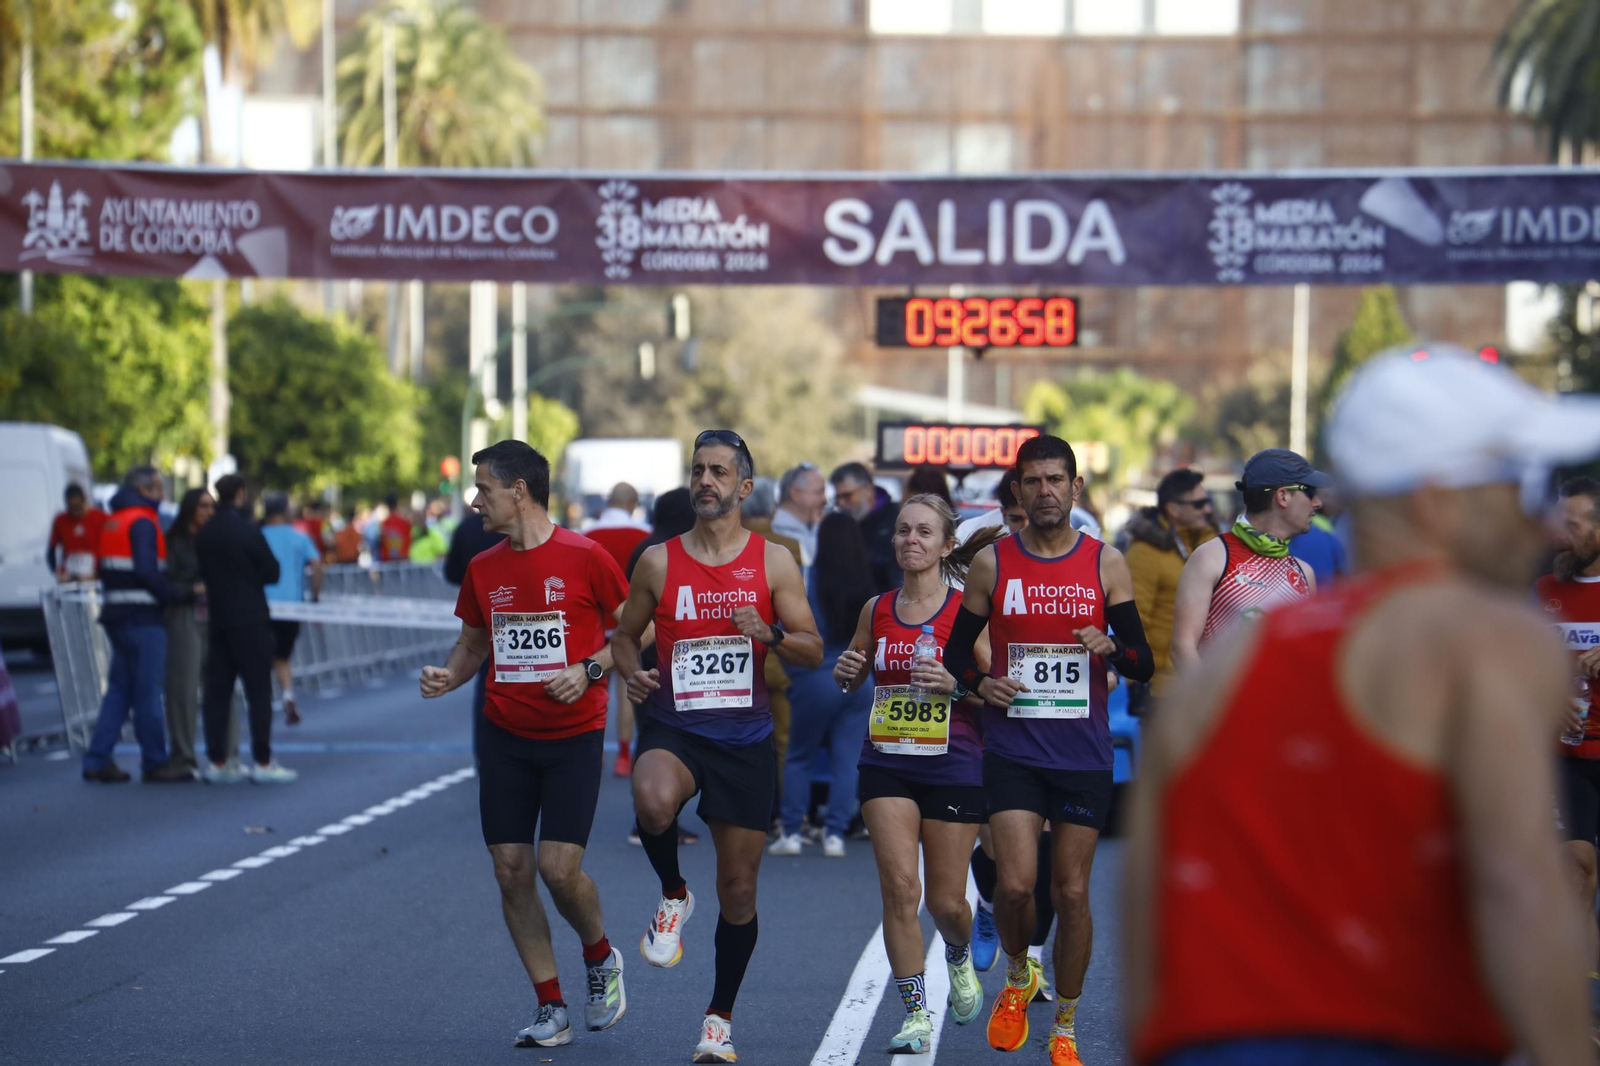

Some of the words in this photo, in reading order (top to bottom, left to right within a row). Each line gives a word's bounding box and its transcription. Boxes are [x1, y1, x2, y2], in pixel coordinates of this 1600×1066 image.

[99, 198, 261, 228] AYUNTAMIENTO
[641, 197, 721, 223] MEDIA
[1254, 200, 1335, 224] MEDIA
[100, 224, 126, 250] DE
[383, 204, 560, 244] IMDECO
[595, 214, 641, 250] 38
[641, 214, 770, 249] MARATÓN
[822, 198, 1127, 266] SALIDA
[1207, 217, 1254, 253] 38
[1253, 215, 1387, 250] MARATÓN
[724, 250, 769, 272] 2024
[1340, 253, 1385, 274] 2024
[905, 298, 1074, 347] 092658
[675, 585, 757, 620] Antorcha
[1003, 578, 1096, 615] Antorcha
[494, 614, 507, 628] 38
[508, 628, 562, 650] 3266
[674, 642, 690, 655] 38
[690, 652, 750, 675] 3267
[1010, 646, 1025, 659] 38
[1034, 661, 1080, 684] 815
[877, 688, 891, 700] 38
[888, 700, 947, 723] 5983
